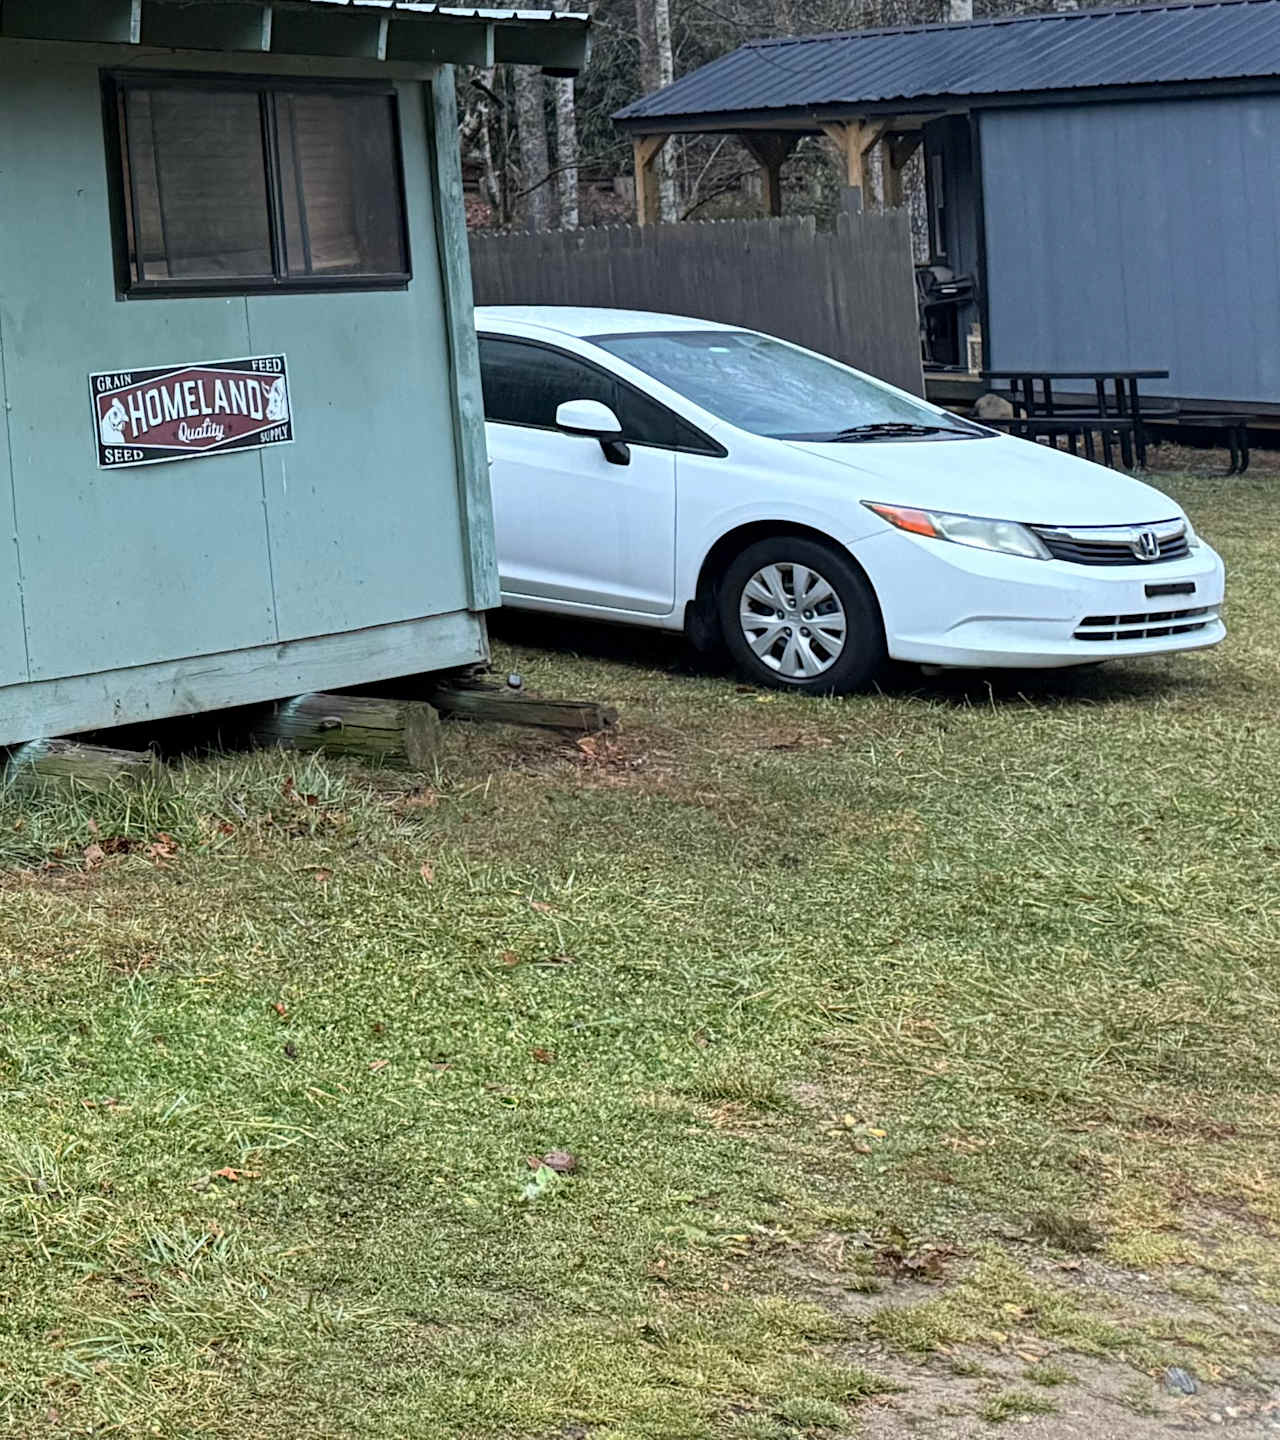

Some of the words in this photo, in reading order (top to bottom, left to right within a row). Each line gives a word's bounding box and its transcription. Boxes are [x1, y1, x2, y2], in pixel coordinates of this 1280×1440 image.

[251, 358, 282, 372] FEED
[96, 373, 132, 392] GRAIN
[127, 378, 264, 438] HOMELAND
[178, 417, 225, 443] Quality
[260, 424, 289, 443] SUPPLY
[104, 448, 144, 463] SEED
